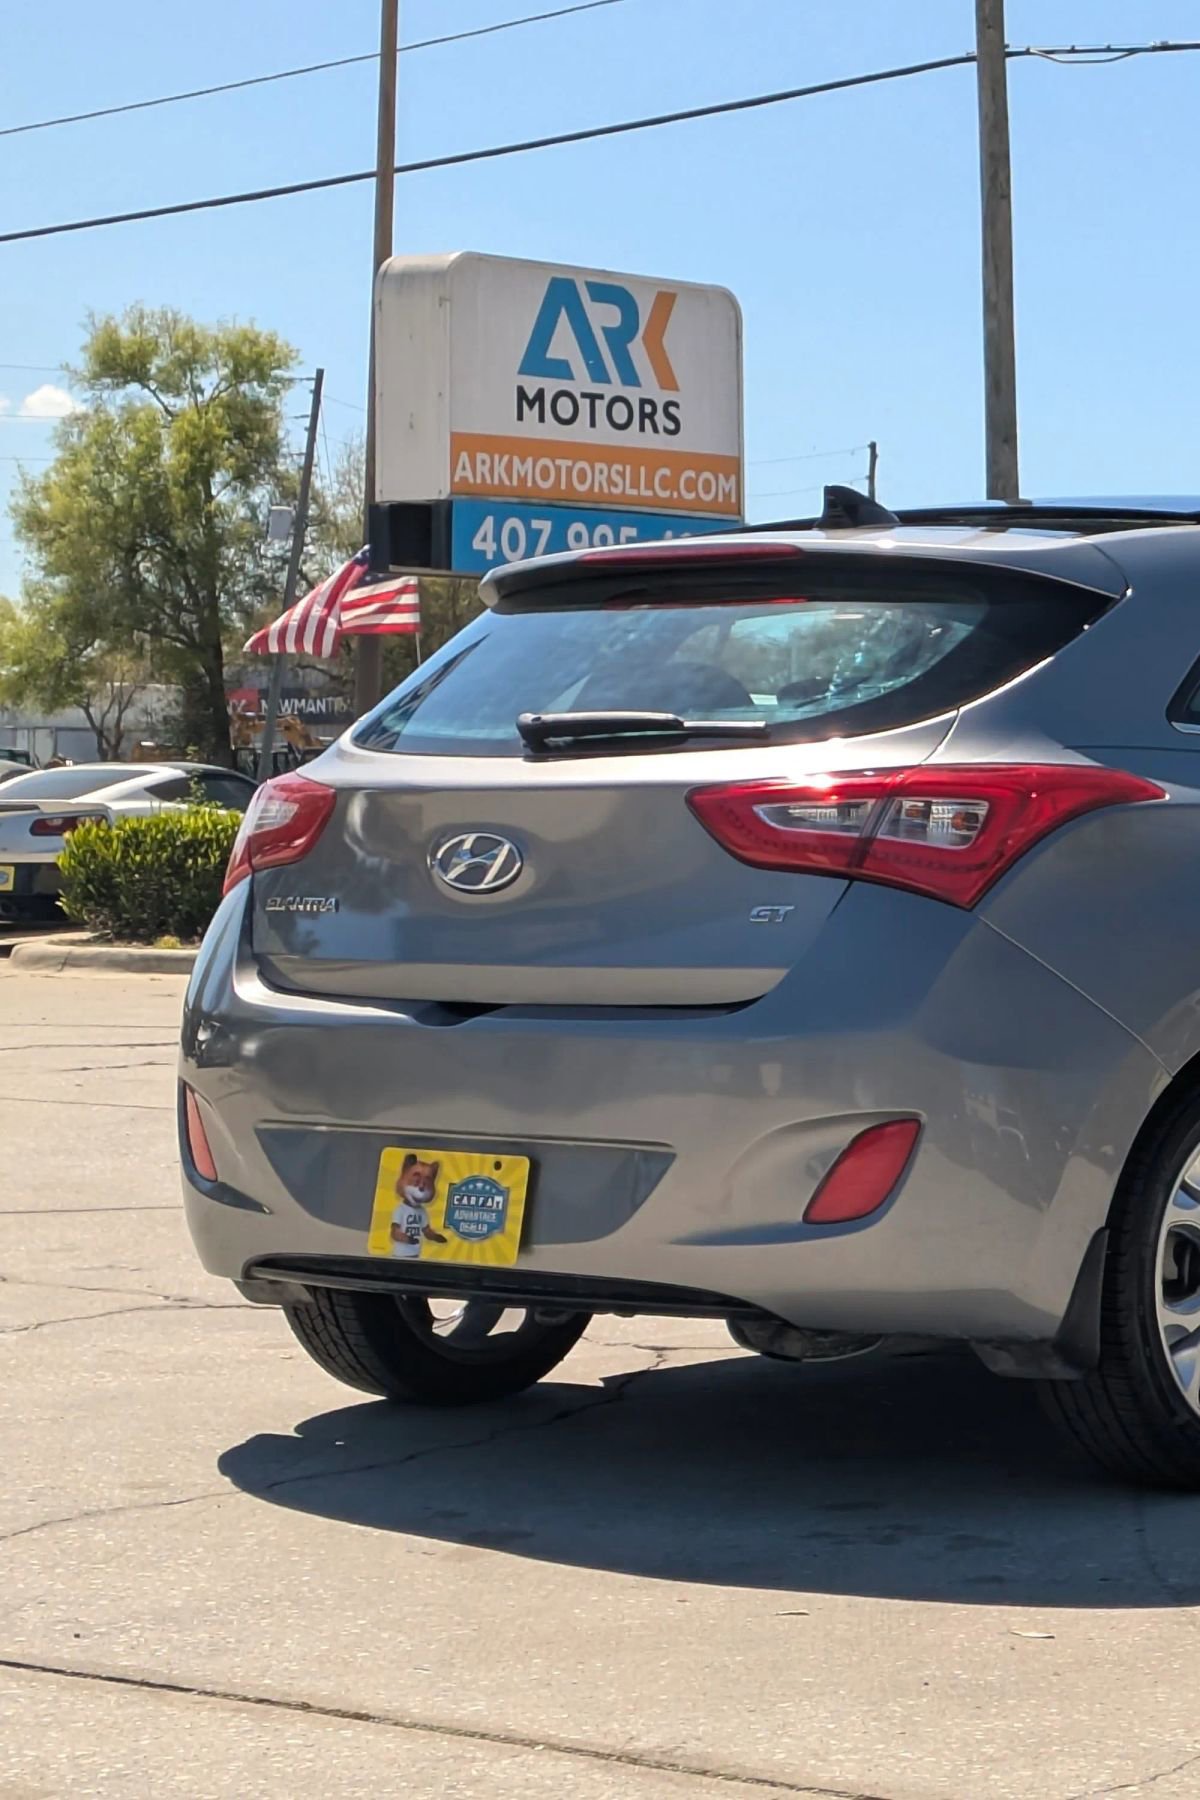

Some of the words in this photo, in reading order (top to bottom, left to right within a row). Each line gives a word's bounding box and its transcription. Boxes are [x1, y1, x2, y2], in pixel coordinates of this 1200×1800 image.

[517, 276, 680, 392] ARK
[516, 385, 682, 436] MOTORS
[453, 450, 738, 503] ARKMOTORSLLC.COM
[472, 515, 553, 562] 407
[749, 905, 795, 922] GT
